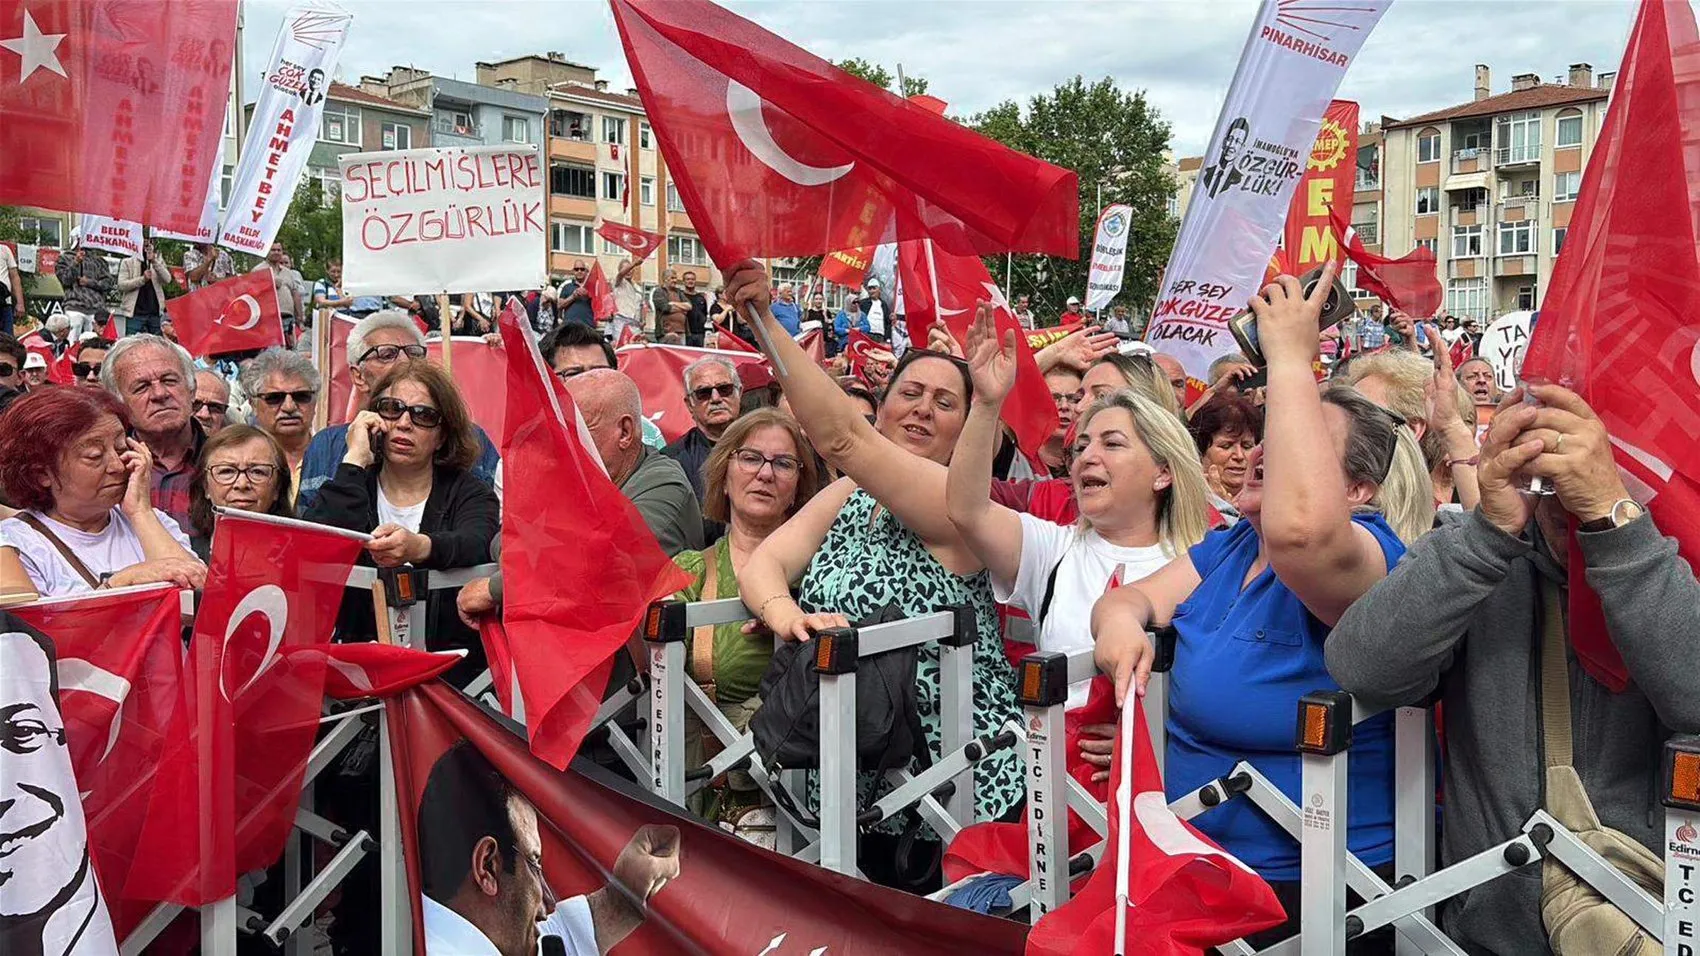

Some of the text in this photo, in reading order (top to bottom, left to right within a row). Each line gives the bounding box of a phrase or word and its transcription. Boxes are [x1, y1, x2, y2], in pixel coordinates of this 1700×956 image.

[1260, 25, 1349, 67] PINARHİSAR
[1314, 139, 1339, 151] MEP
[345, 151, 541, 203] SEÇİLMİŞLERE
[361, 198, 544, 251] ÖZGÜRLÜK
[1152, 323, 1218, 347] OLACAK
